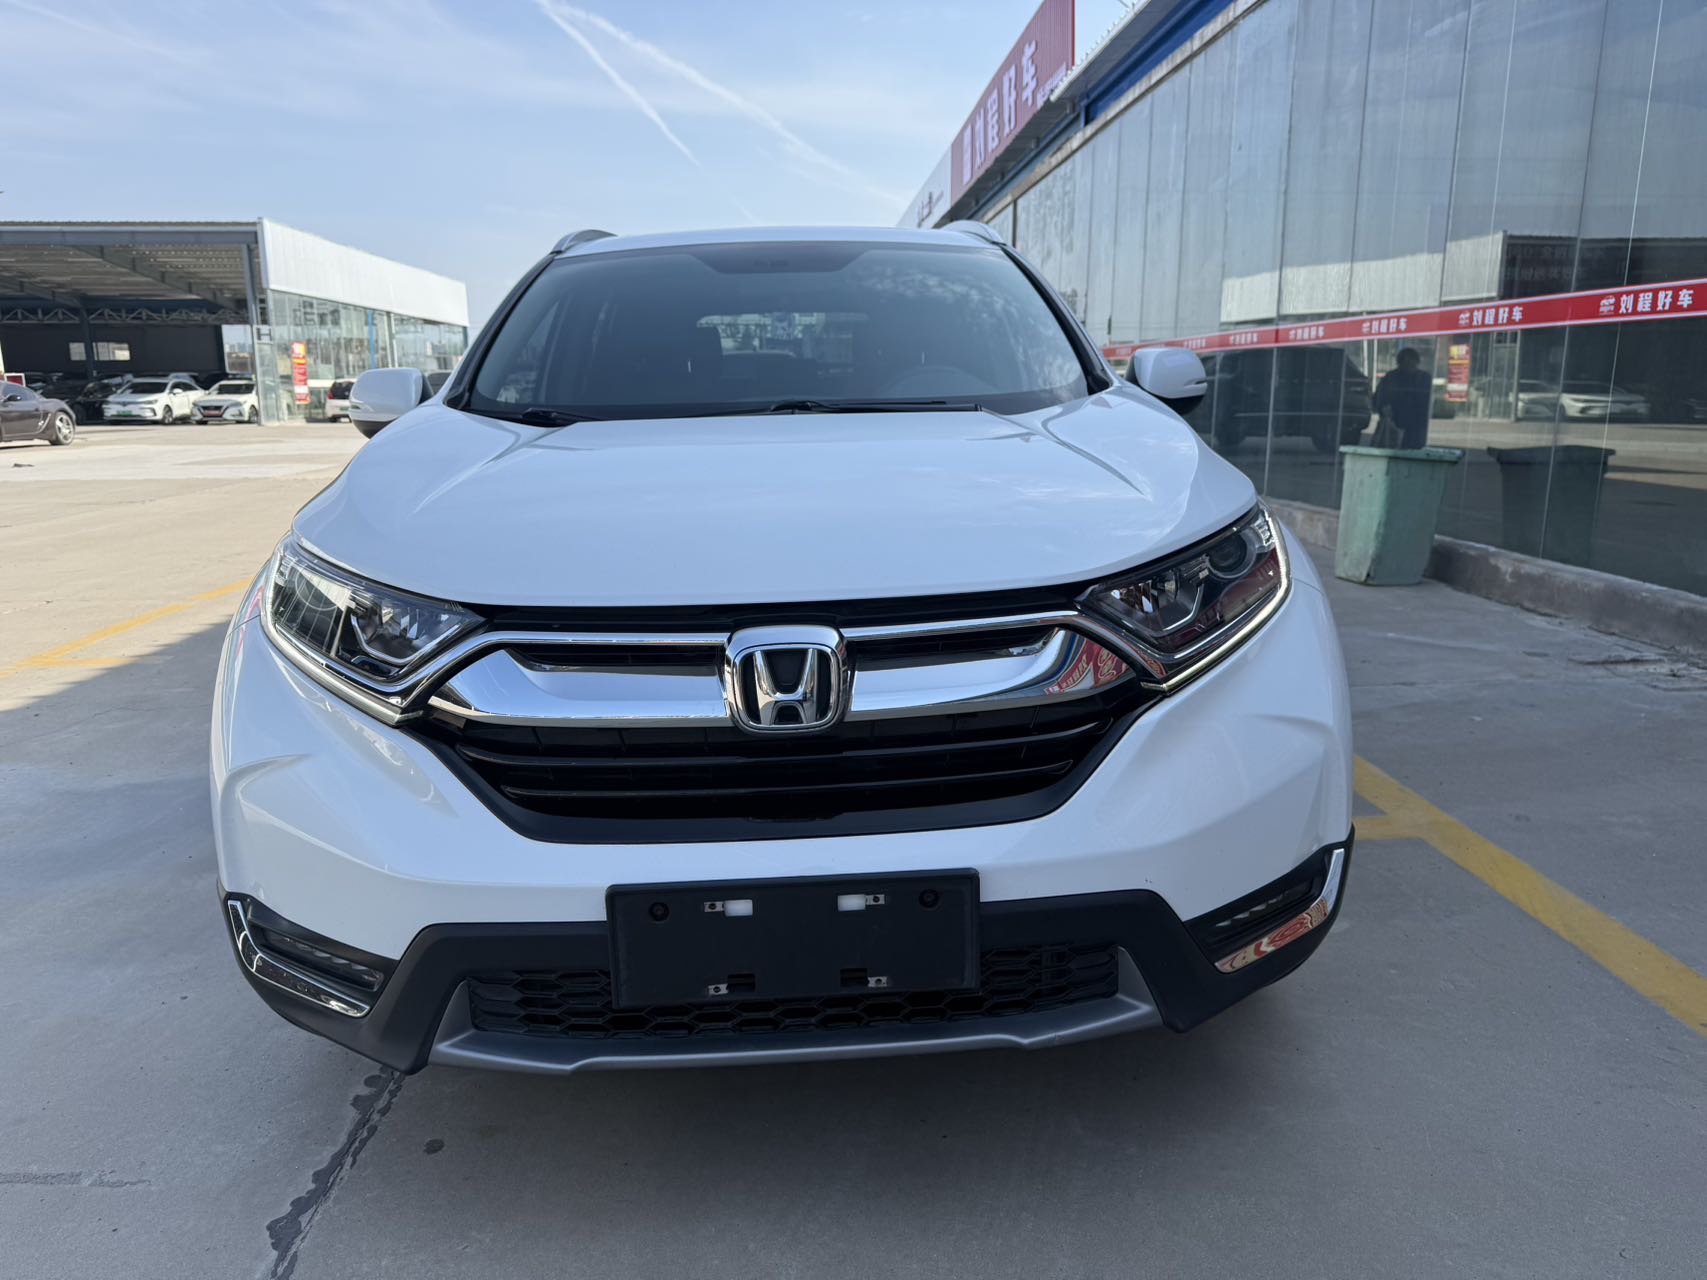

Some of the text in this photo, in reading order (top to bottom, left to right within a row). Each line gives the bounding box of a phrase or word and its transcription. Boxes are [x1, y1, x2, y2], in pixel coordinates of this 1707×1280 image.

[1619, 289, 1694, 314] 刘程好车
[1472, 306, 1523, 326] 刘程好车
